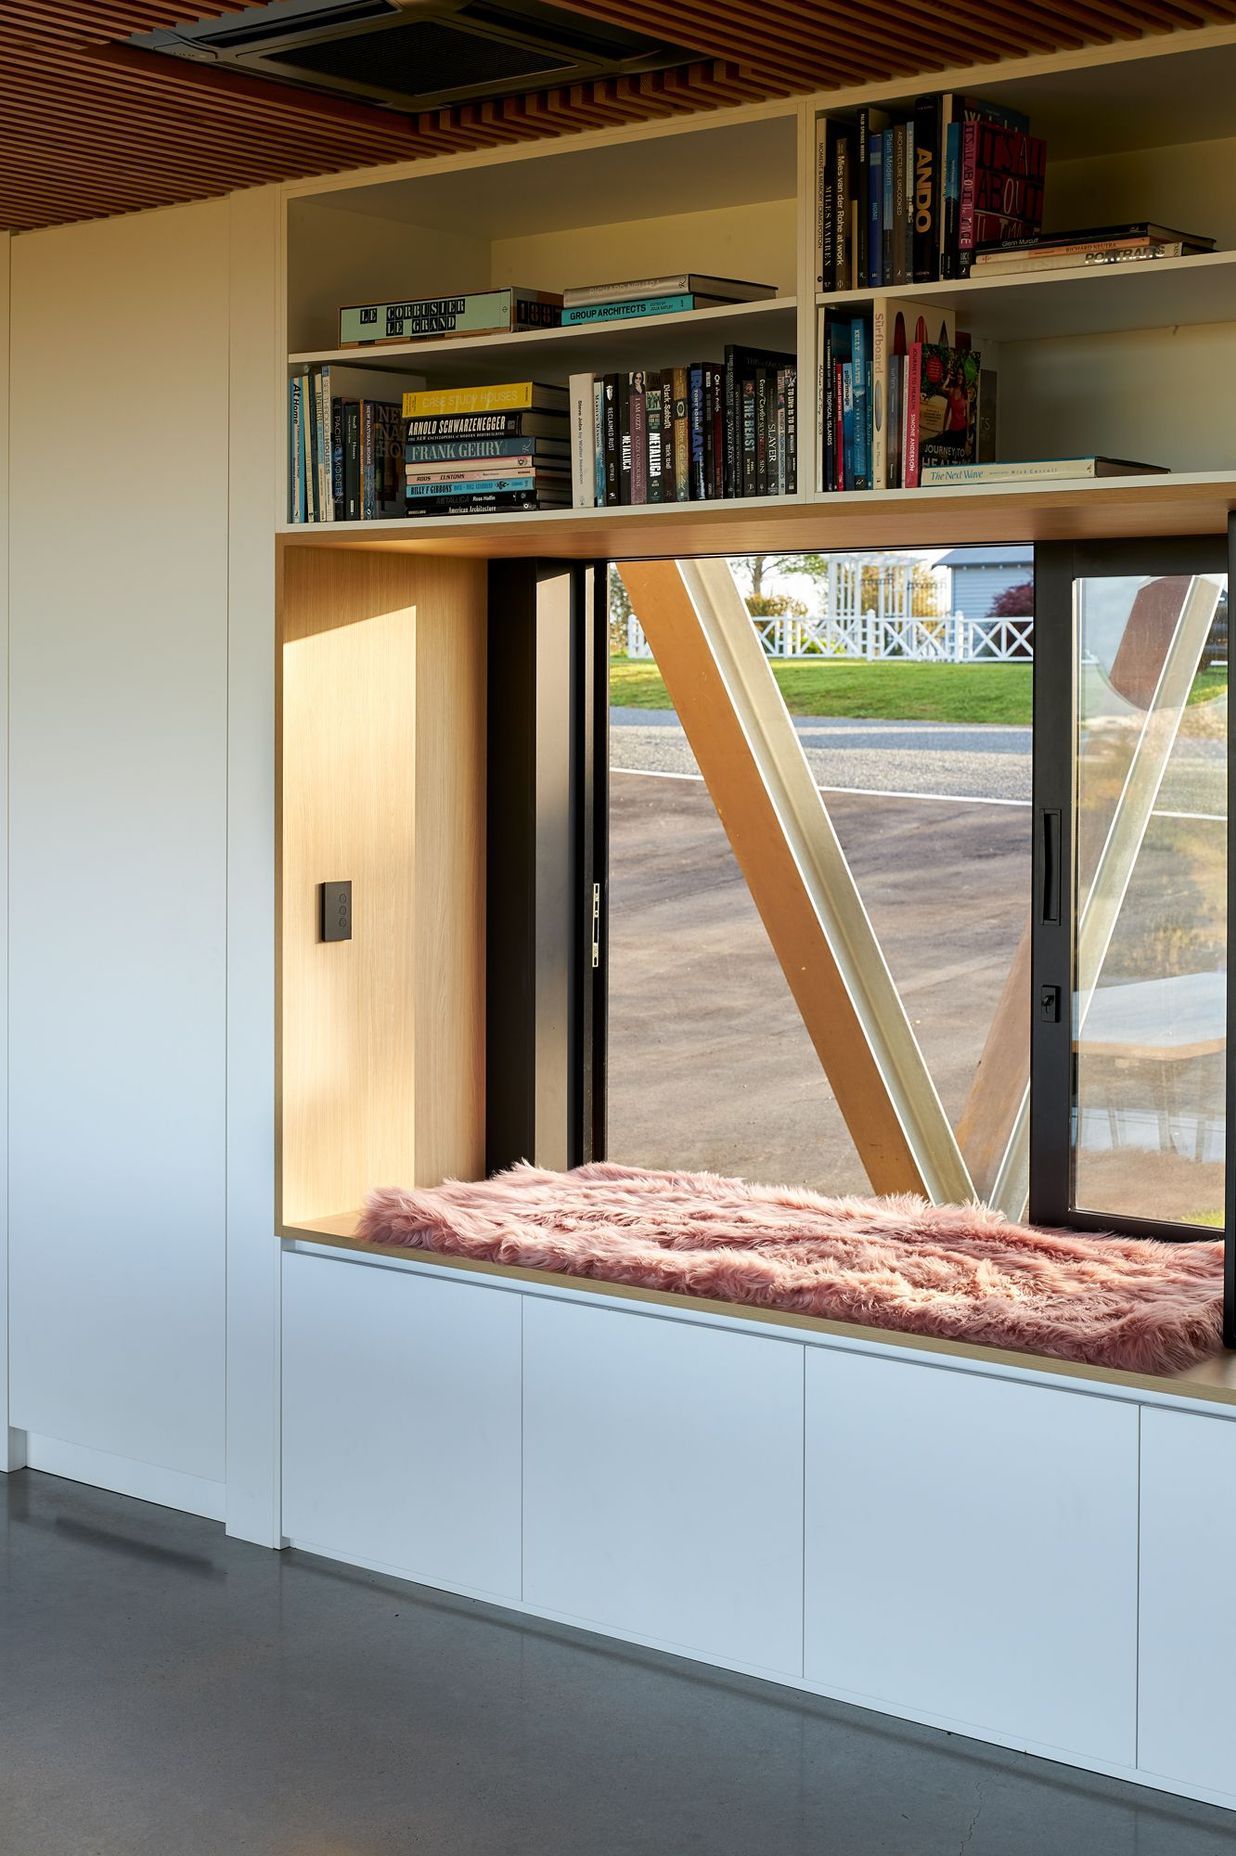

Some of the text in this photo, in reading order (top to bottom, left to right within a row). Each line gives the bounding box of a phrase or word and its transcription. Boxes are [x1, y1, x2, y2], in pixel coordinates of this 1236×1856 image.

[916, 148, 932, 233] ANDO
[962, 166, 974, 202] ABOUT
[837, 234, 844, 243] at
[1002, 239, 1018, 248] Glenn
[361, 299, 465, 323] LE CORBUSIER
[570, 304, 646, 320] GROUP ARCHITECTS
[386, 316, 455, 336] LE GRAND
[293, 384, 301, 398] At
[422, 398, 446, 408] CASE
[449, 394, 477, 405] STUDY
[481, 390, 518, 403] HOUSES
[636, 402, 640, 413] AM
[408, 420, 437, 436] ARNOLD
[439, 416, 506, 434] SCHWARZENEGGER
[744, 399, 755, 453] THE BEAST
[412, 440, 503, 460] FRANK GEHRY
[623, 435, 631, 470] METALLICA
[768, 424, 776, 463] SLAYER
[924, 445, 965, 456] JOURNEY TO
[649, 433, 661, 477] METALLICA
[334, 457, 343, 503] MODERN
[931, 470, 983, 480] The Next Wave
[411, 484, 452, 495] BILLY F GIBBONS
